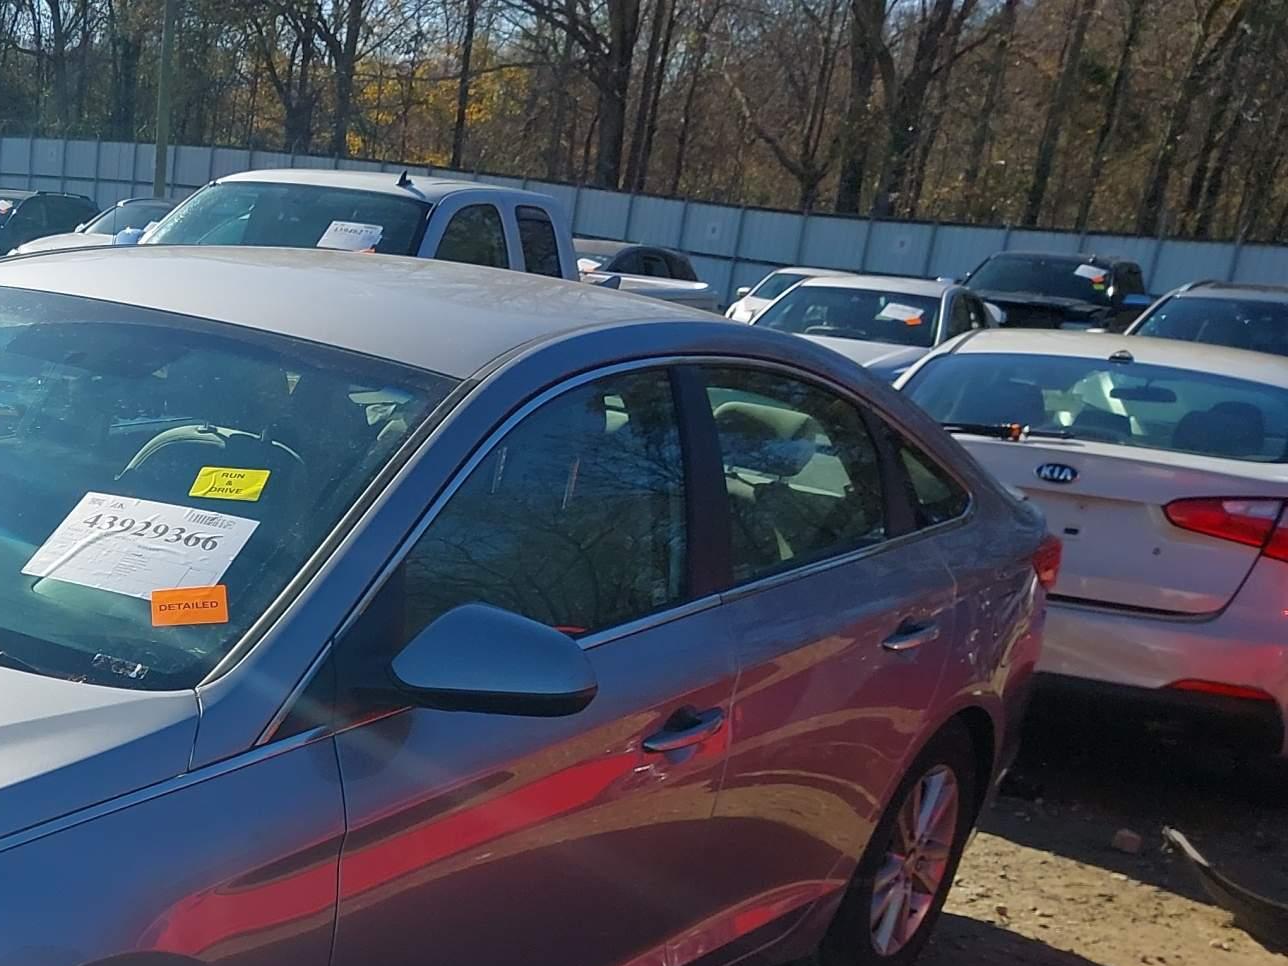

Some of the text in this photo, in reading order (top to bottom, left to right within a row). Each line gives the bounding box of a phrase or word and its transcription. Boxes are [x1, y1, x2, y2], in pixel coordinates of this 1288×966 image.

[1039, 465, 1072, 481] KIA
[209, 486, 243, 494] DRIVE
[83, 513, 223, 551] 43929366
[159, 600, 219, 612] DETAILED
